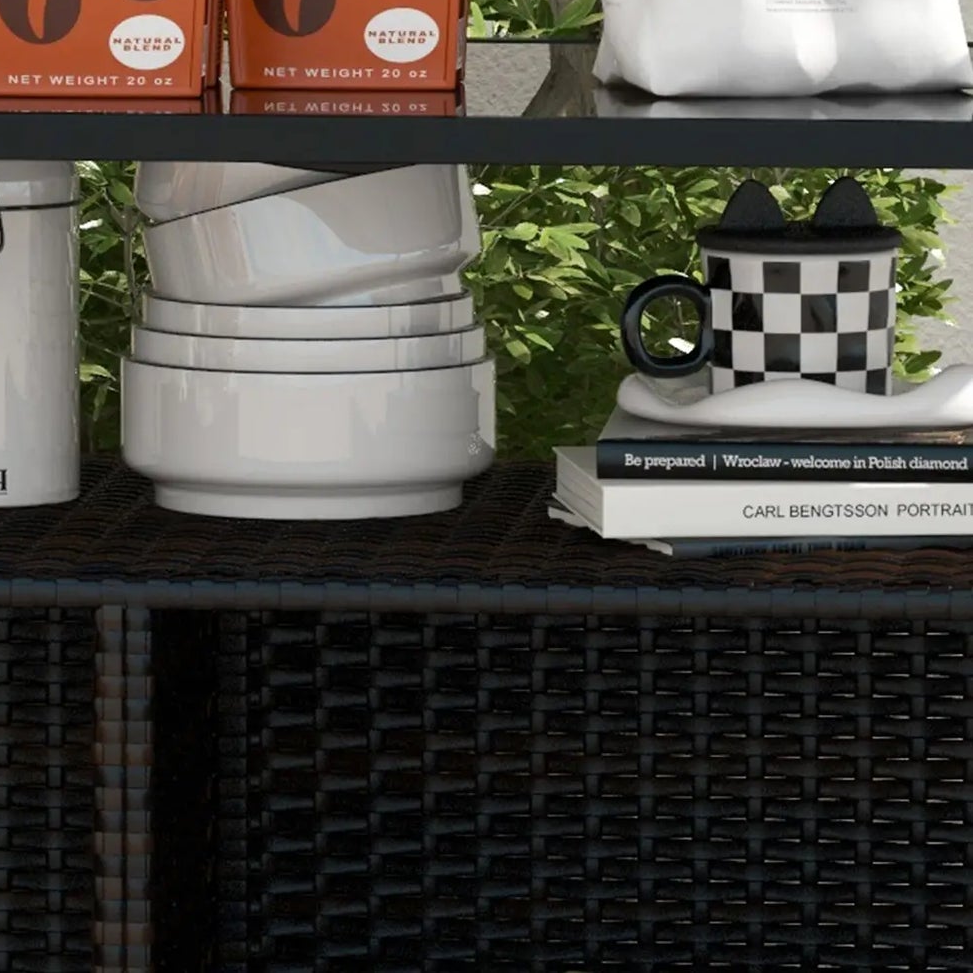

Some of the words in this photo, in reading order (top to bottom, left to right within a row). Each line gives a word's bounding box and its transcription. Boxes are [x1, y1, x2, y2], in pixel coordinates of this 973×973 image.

[113, 37, 181, 45] NATURAL
[123, 44, 172, 52] BLEND
[264, 67, 298, 77] NET
[305, 68, 374, 78] WEIGHT
[381, 69, 401, 78] 20
[409, 69, 428, 78] oz
[8, 75, 42, 85] NET
[50, 75, 119, 86] WEIGHT
[126, 76, 147, 86] 20
[154, 77, 173, 86] oz
[624, 454, 642, 467] Be
[644, 454, 706, 470] prepared
[722, 454, 782, 468] Wroclaw
[790, 455, 851, 469] welcome
[853, 456, 866, 469] in
[868, 457, 907, 469] Polish
[909, 457, 969, 470] diamond
[742, 505, 785, 518] CARL
[789, 504, 889, 518] BENGTSSON
